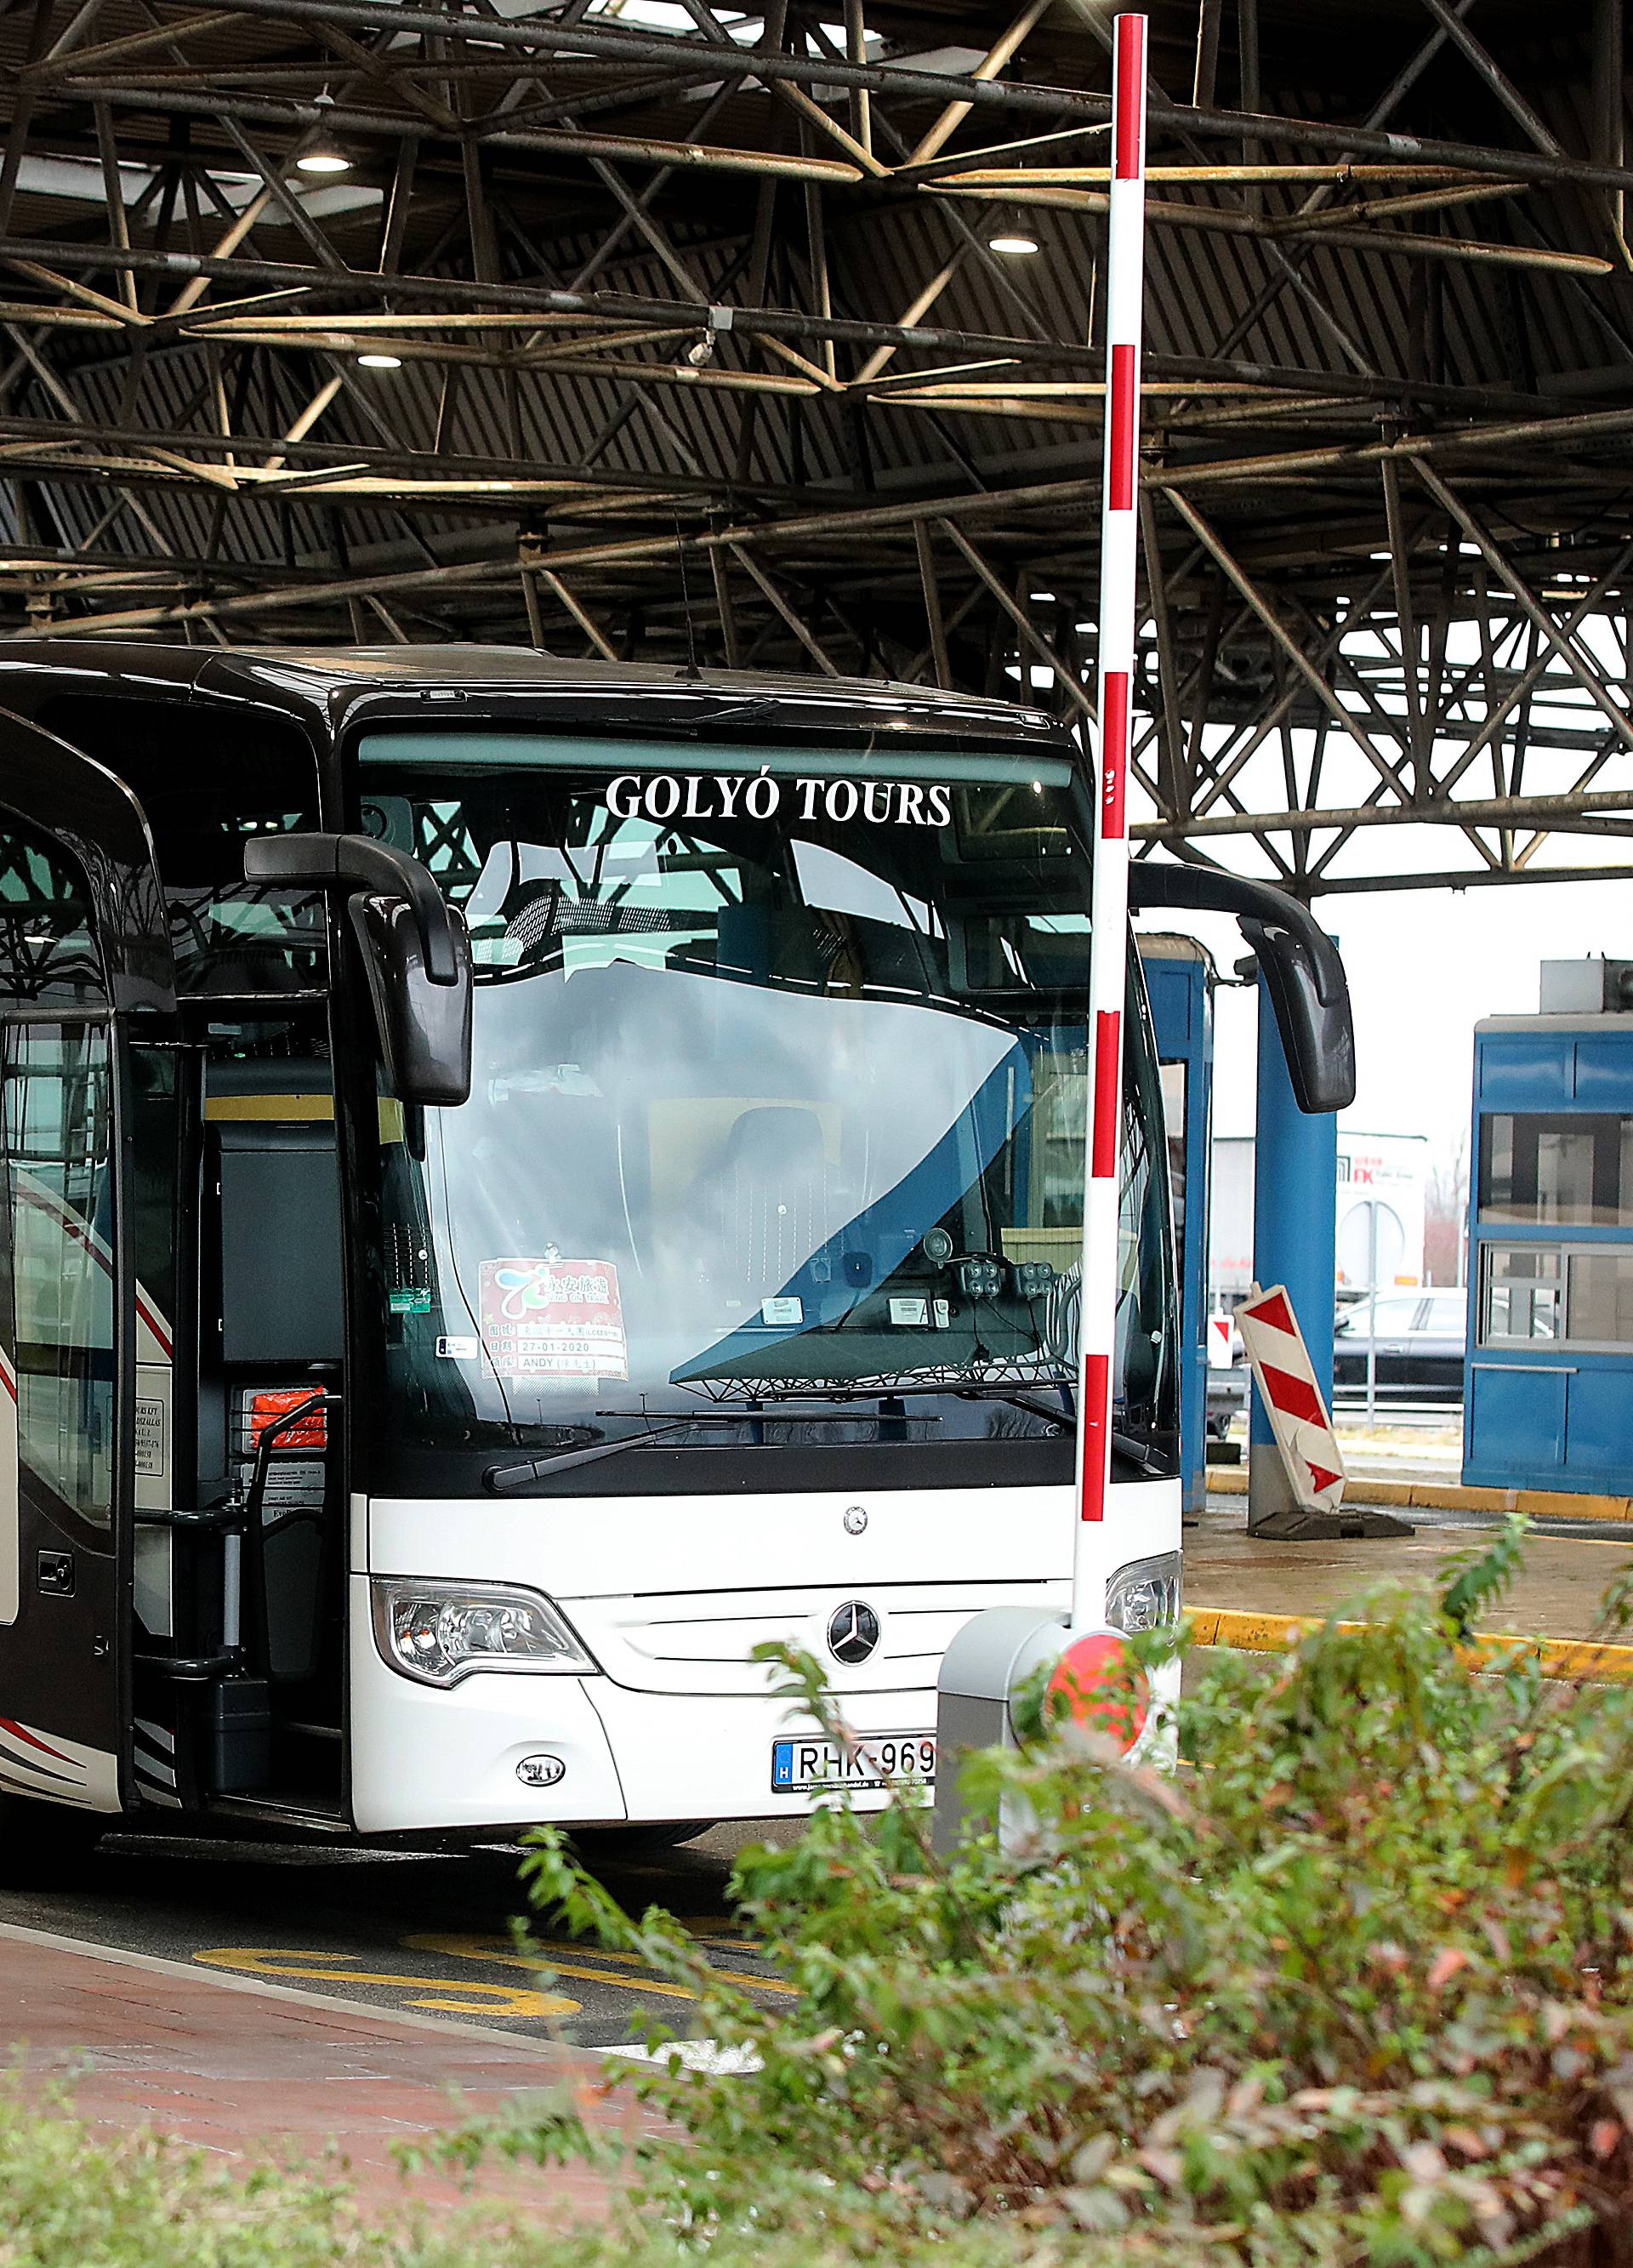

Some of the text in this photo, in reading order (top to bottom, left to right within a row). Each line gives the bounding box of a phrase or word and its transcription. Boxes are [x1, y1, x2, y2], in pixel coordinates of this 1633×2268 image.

[606, 765, 952, 827] GOLYÓ TOURS
[522, 1342, 589, 1352] 27-01-2020
[523, 1359, 554, 1367] ANDY
[799, 1741, 934, 1779] RHK-969
[779, 1767, 788, 1779] H
